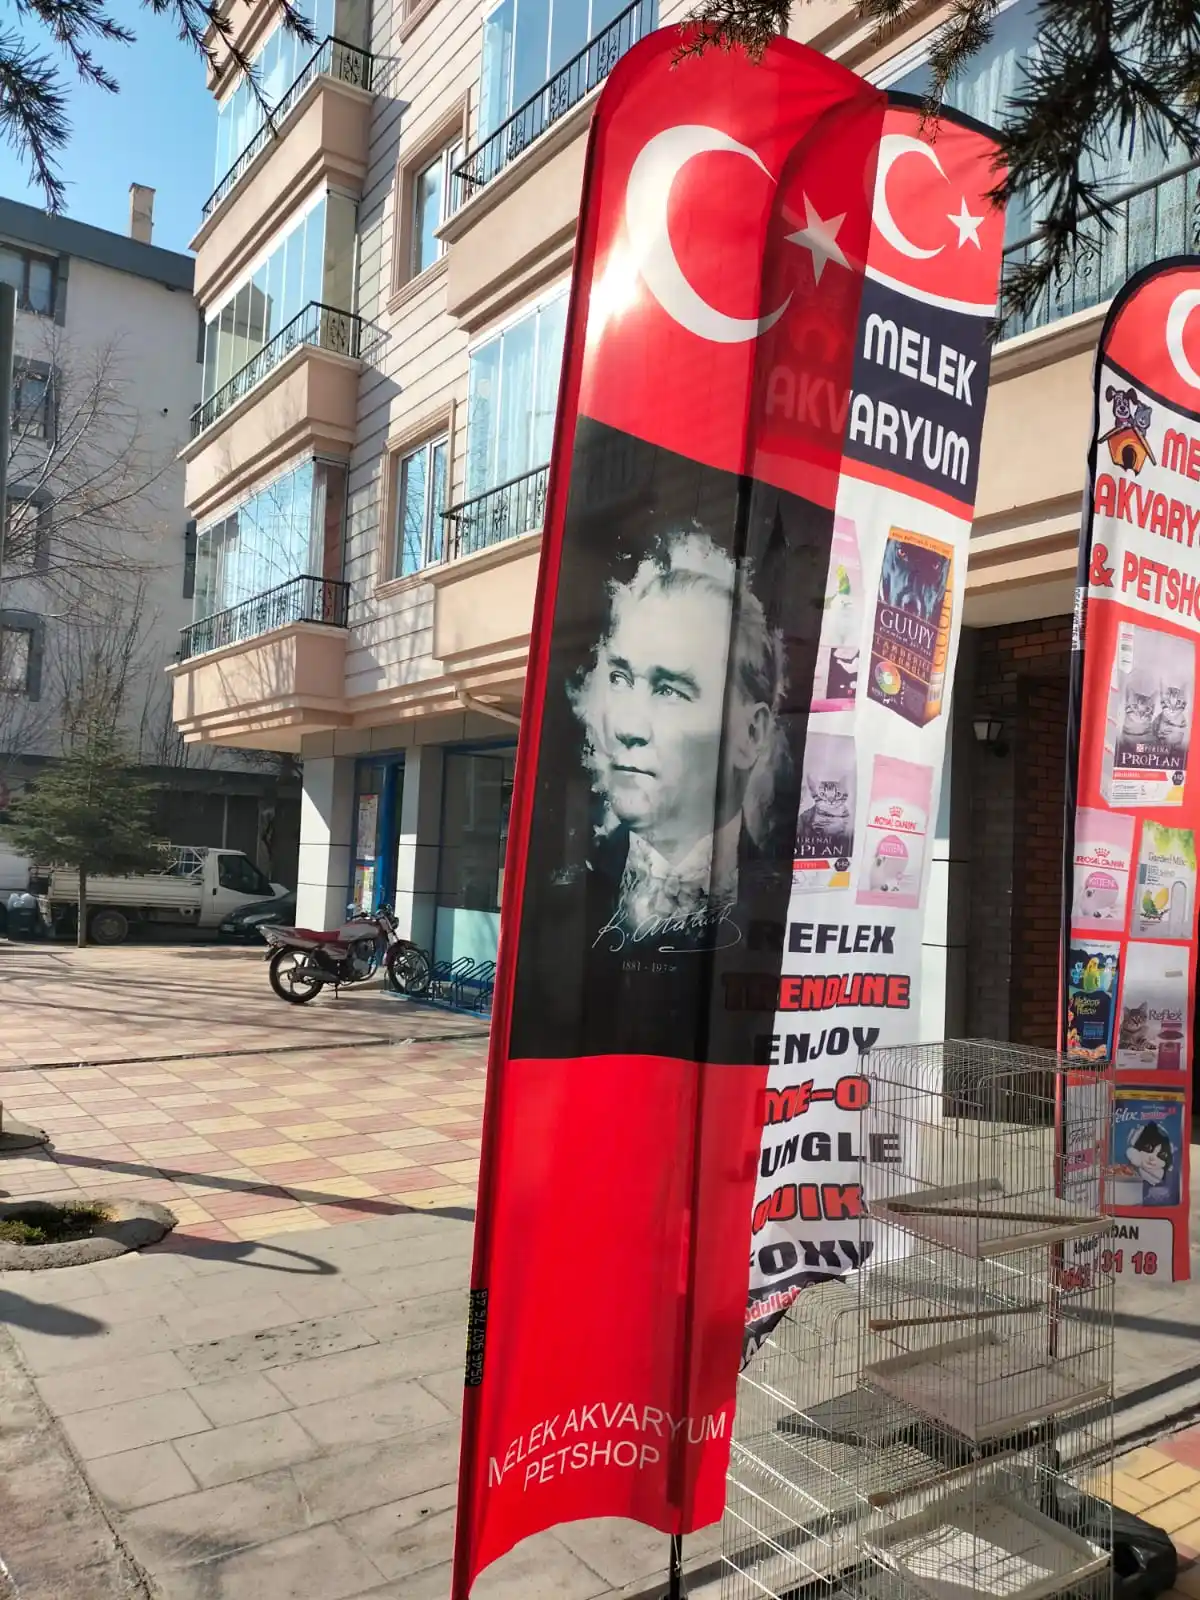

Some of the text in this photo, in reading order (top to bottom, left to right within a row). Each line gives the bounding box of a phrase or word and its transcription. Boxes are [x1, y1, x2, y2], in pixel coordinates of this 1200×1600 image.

[863, 313, 978, 407] MELEK
[765, 366, 970, 485] AKVARYUM
[1094, 473, 1200, 548] AKVARY
[1089, 543, 1115, 588] &
[880, 609, 934, 650] GUUPY
[1076, 855, 1125, 869] ROYAL CANIN
[1148, 1008, 1183, 1021] Reflex
[755, 1026, 881, 1068] ENJOY
[749, 1239, 875, 1277] OXY
[1131, 1250, 1158, 1276] 18
[488, 1402, 726, 1488] MELEK AKVARYUM
[523, 1439, 660, 1492] PETSHOP
